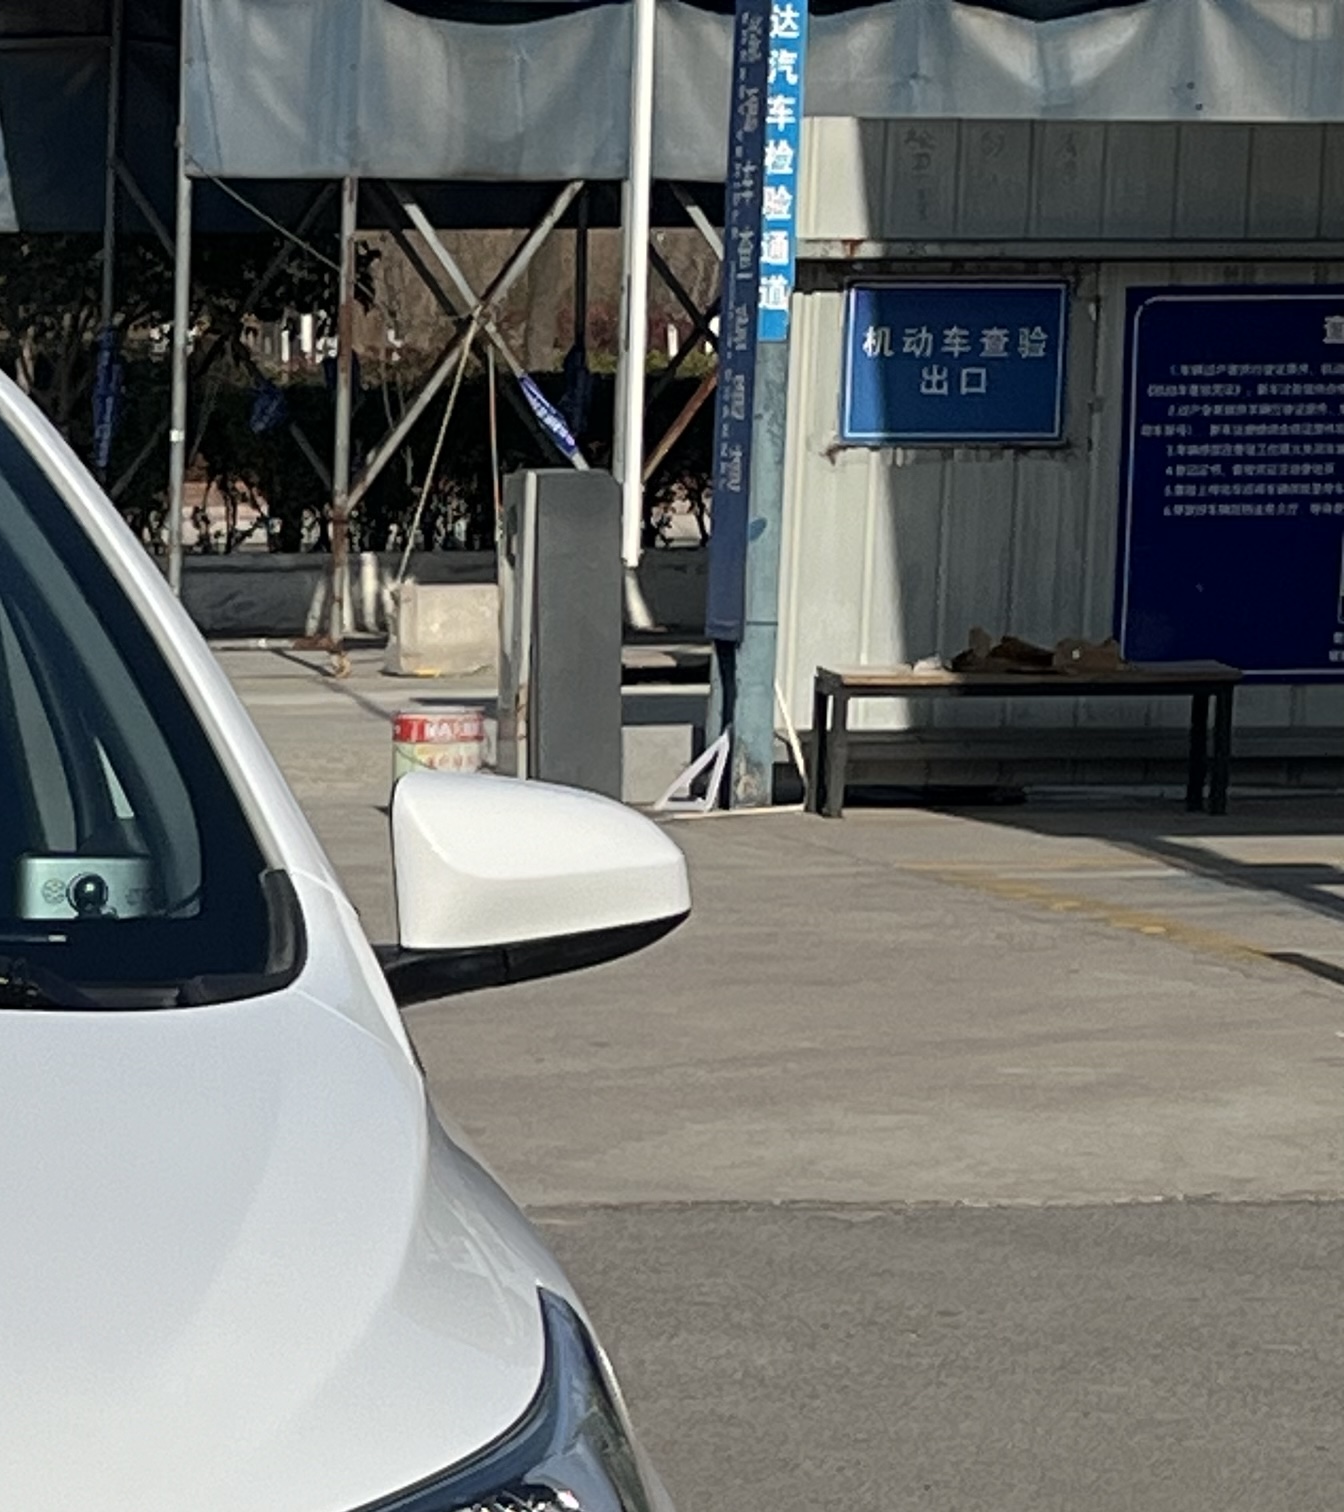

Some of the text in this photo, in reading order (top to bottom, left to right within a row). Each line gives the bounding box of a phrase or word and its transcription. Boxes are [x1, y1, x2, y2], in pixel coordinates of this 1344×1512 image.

[758, 3, 800, 311] 达汽车检验通道
[862, 325, 1048, 359] 机动车查验
[919, 364, 988, 396] 出口
